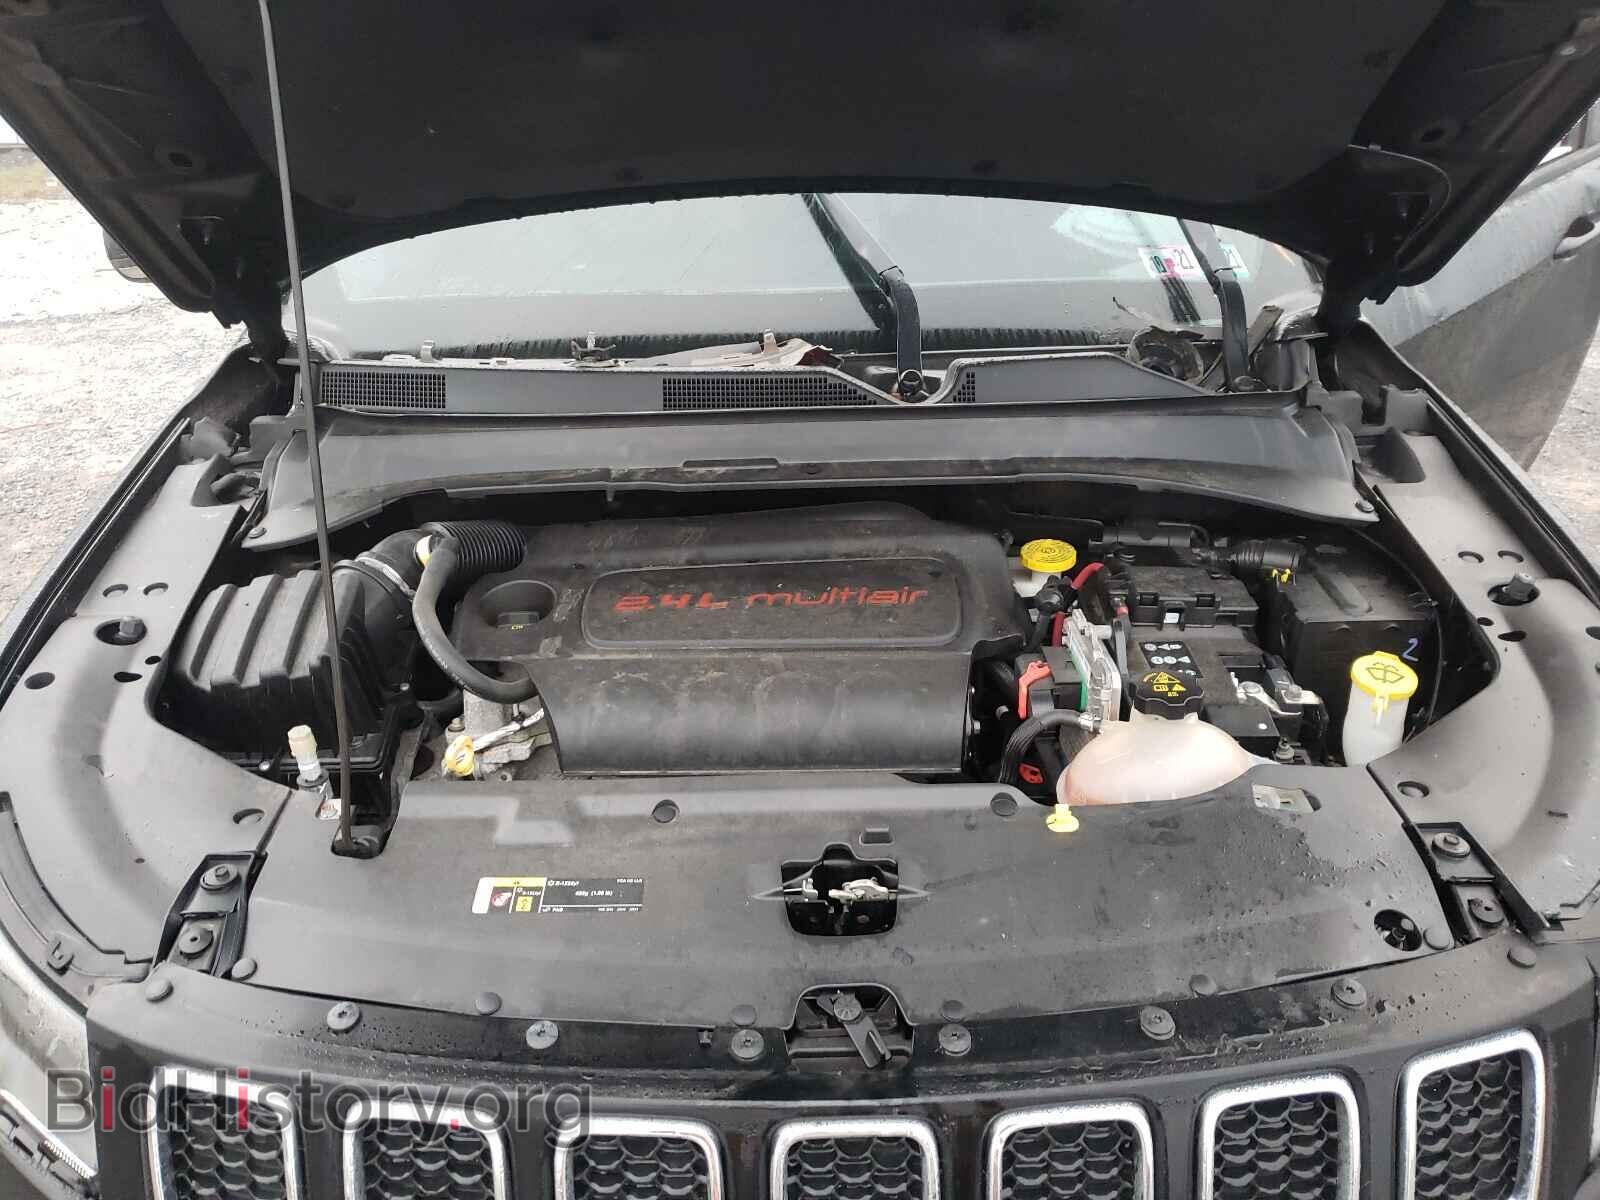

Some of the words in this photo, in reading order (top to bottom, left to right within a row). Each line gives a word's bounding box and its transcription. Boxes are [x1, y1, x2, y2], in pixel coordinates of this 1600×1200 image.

[1173, 248, 1194, 269] 21
[747, 586, 929, 608] multiair
[1402, 637, 1419, 662] 2
